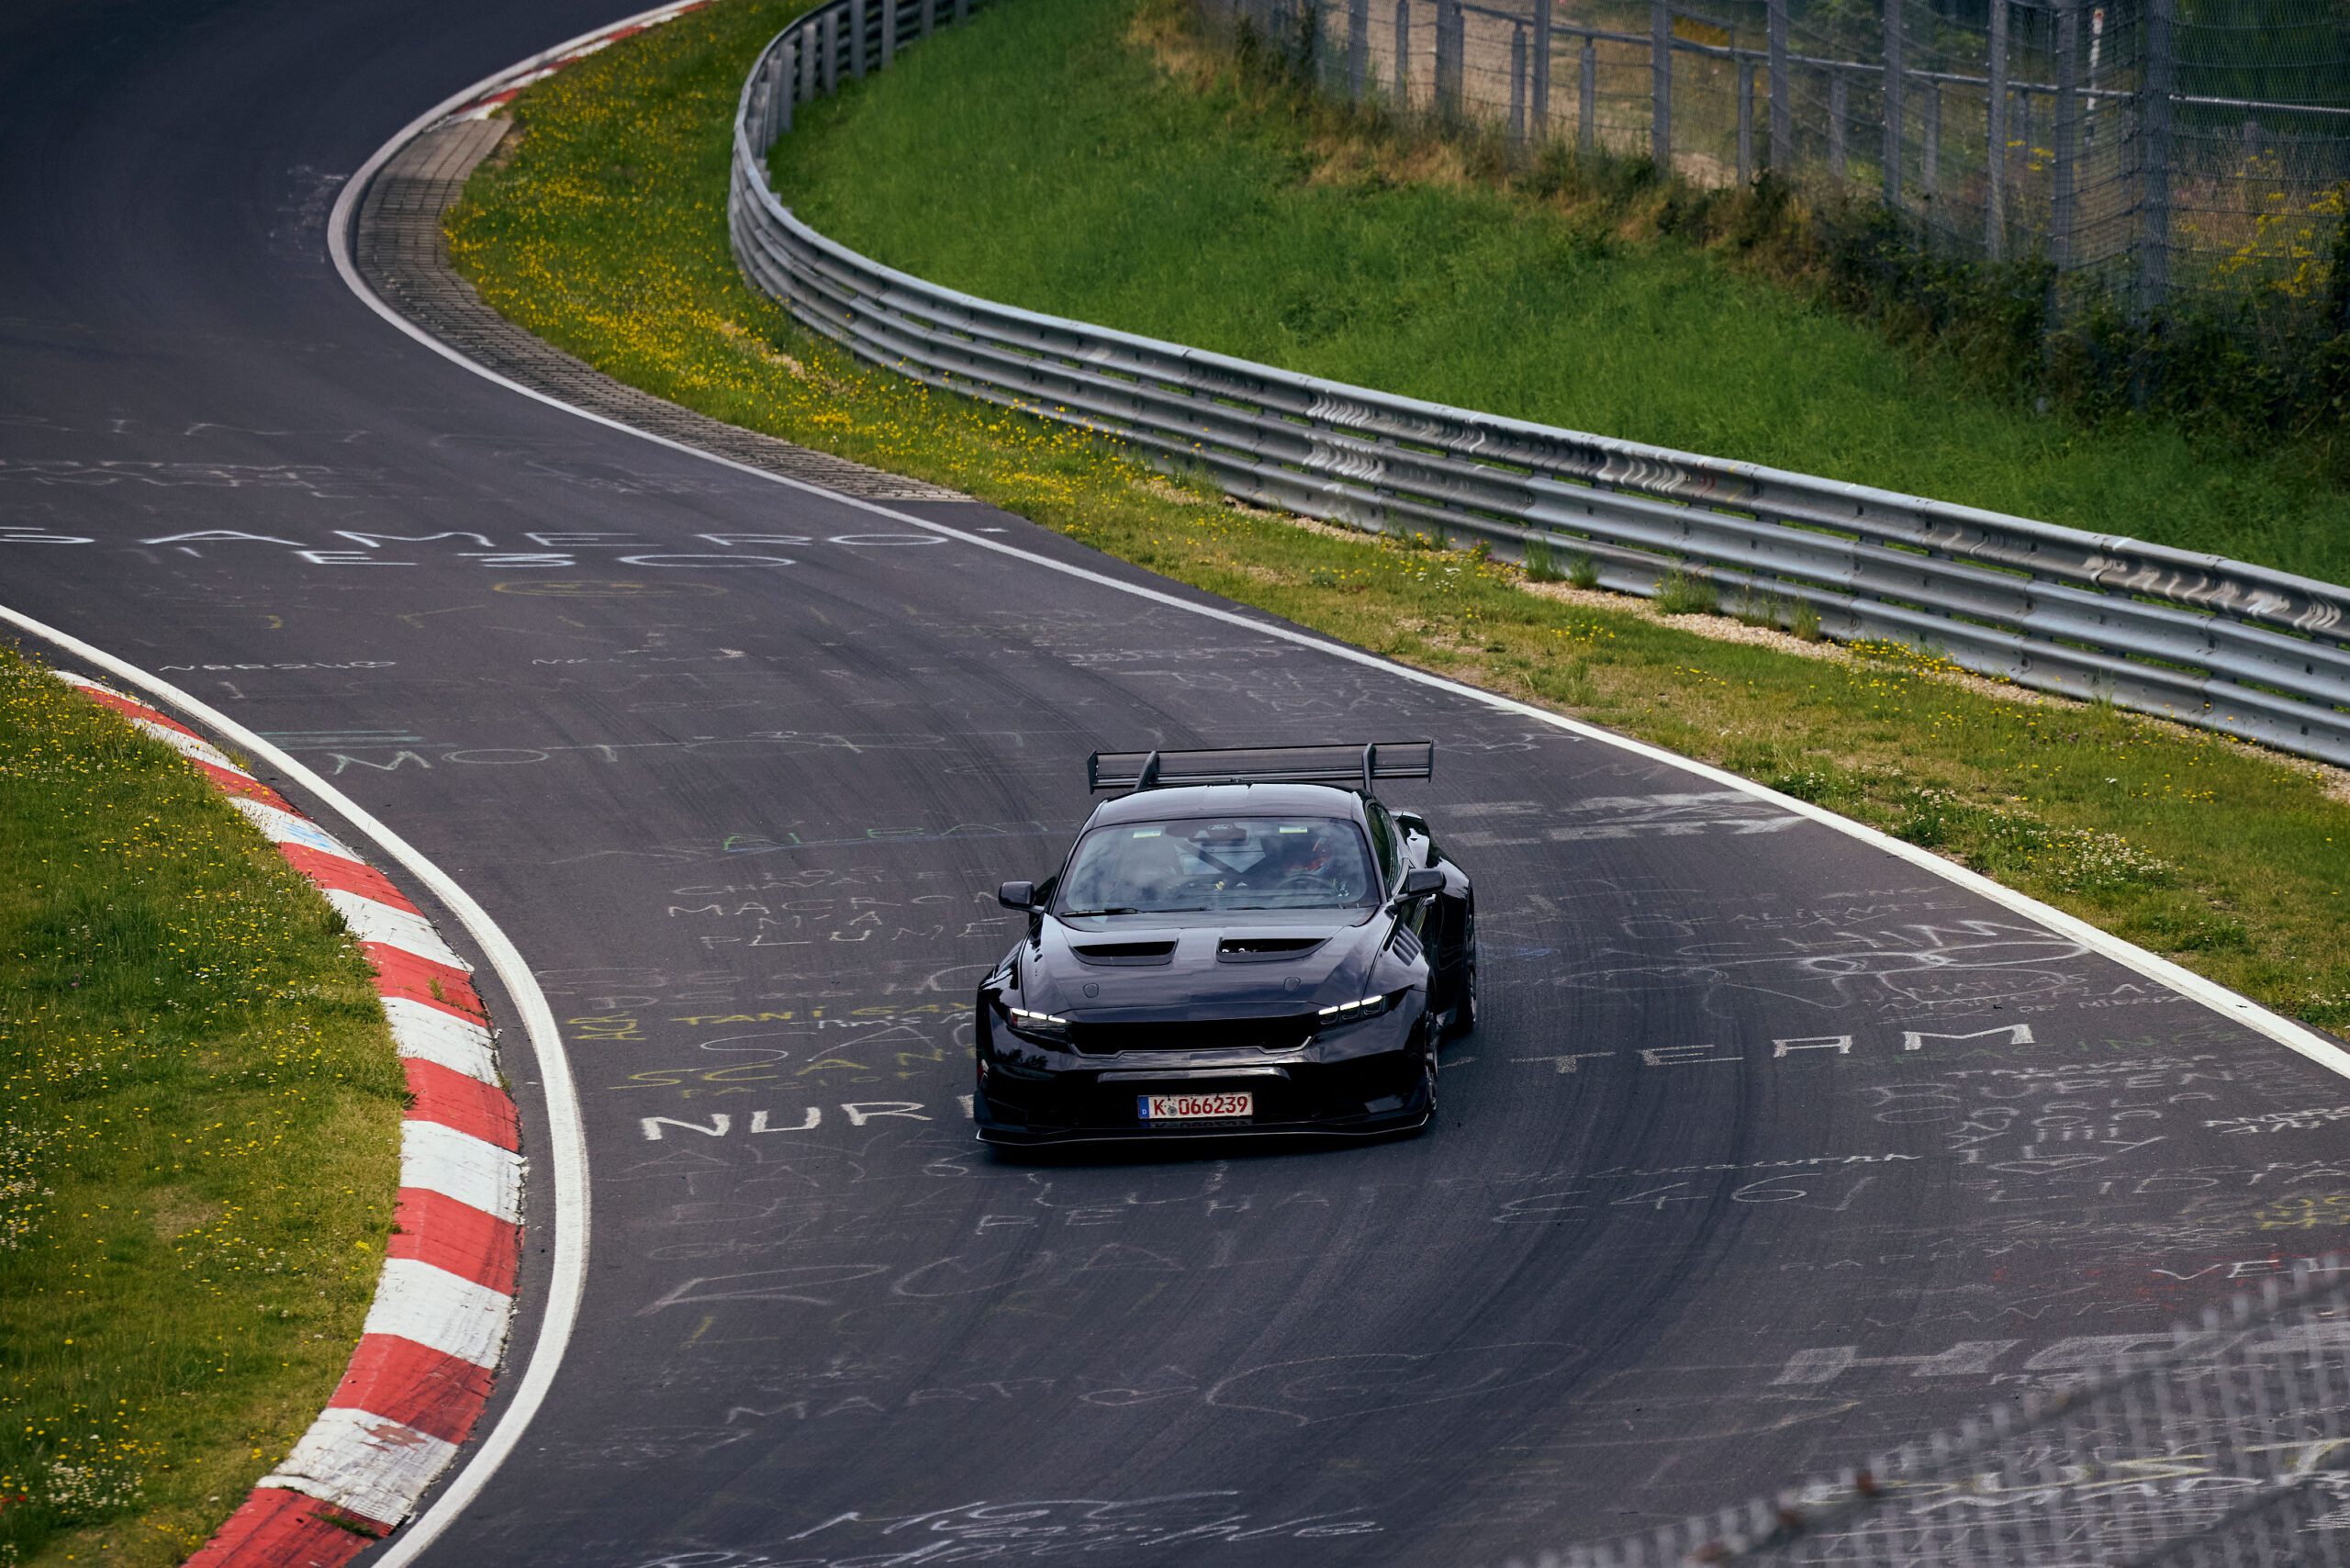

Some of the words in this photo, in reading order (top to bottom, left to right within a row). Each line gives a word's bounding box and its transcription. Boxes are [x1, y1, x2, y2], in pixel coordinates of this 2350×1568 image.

[294, 550, 798, 568] E30
[1508, 1024, 2035, 1074] TEAM
[1154, 1099, 1167, 1115] K
[1179, 1096, 1248, 1115] 066239
